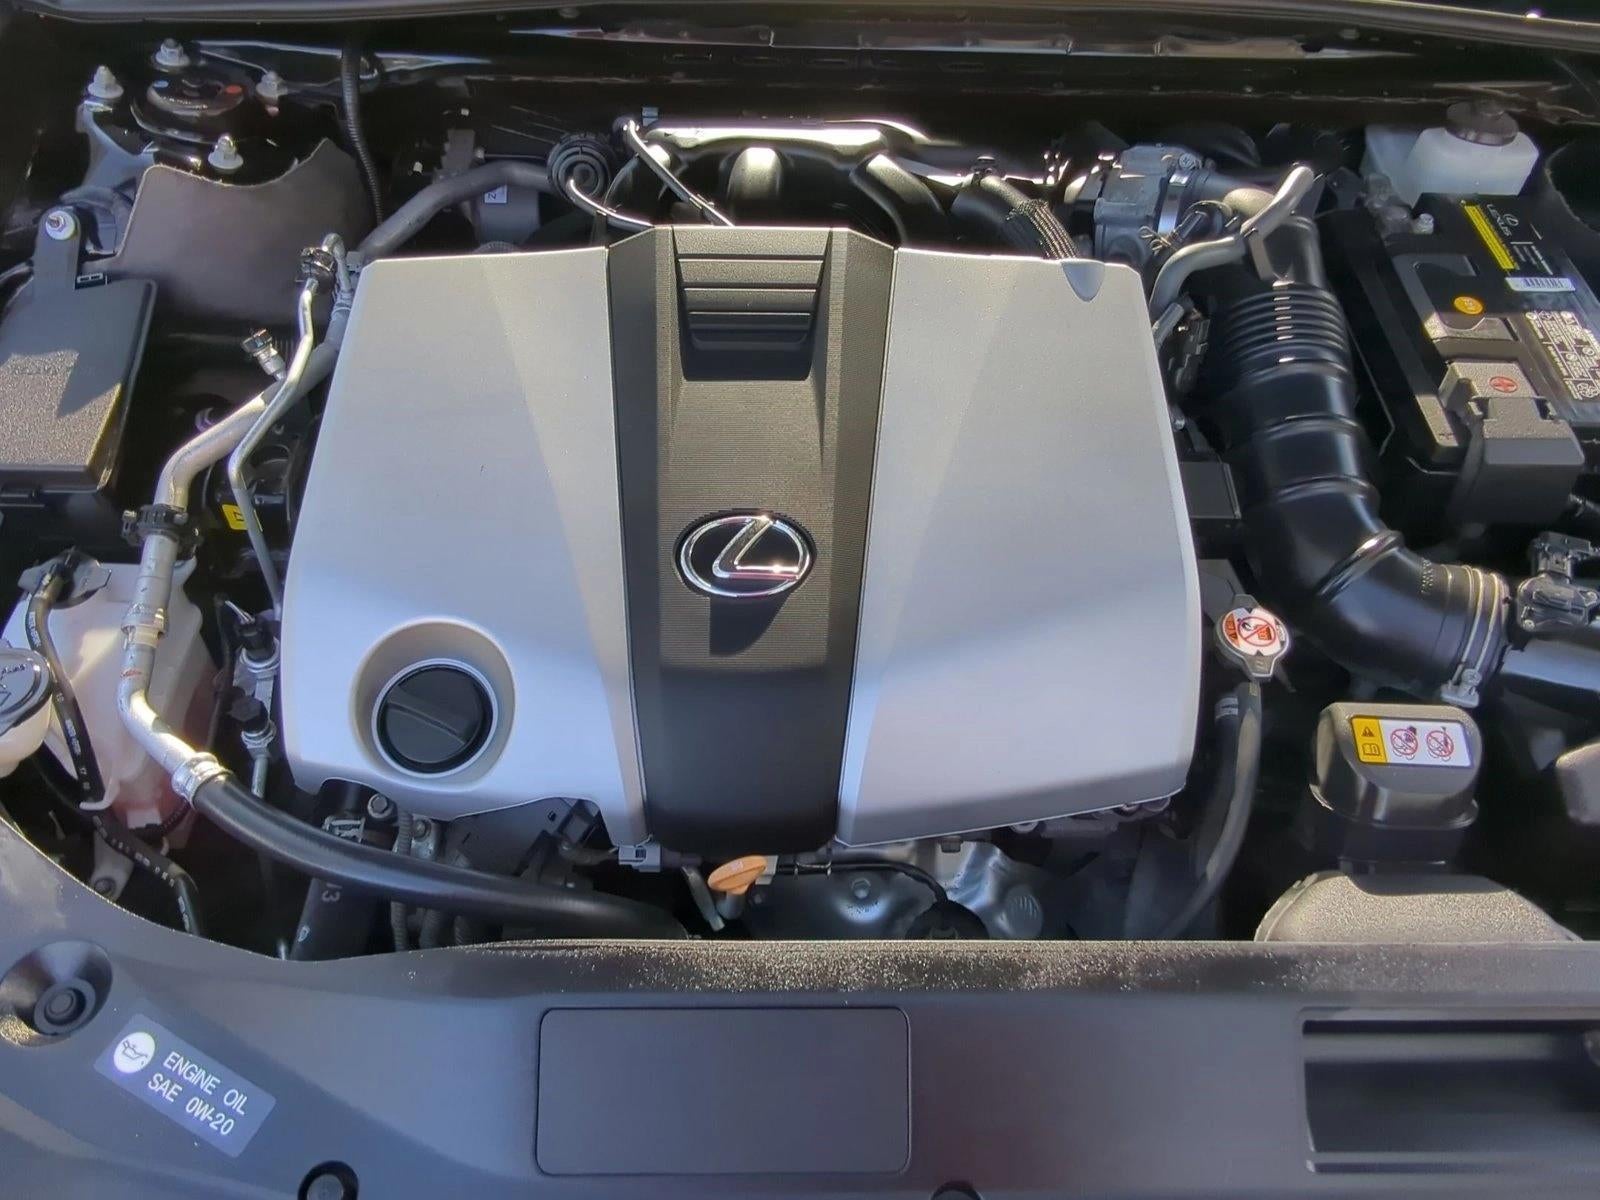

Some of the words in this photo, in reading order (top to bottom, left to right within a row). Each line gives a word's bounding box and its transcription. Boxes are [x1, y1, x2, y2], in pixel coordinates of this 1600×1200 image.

[148, 1073, 183, 1102] SAE
[185, 1096, 235, 1136] 0W-20
[163, 1051, 221, 1095] ENGINE
[223, 1089, 248, 1115] OIL
